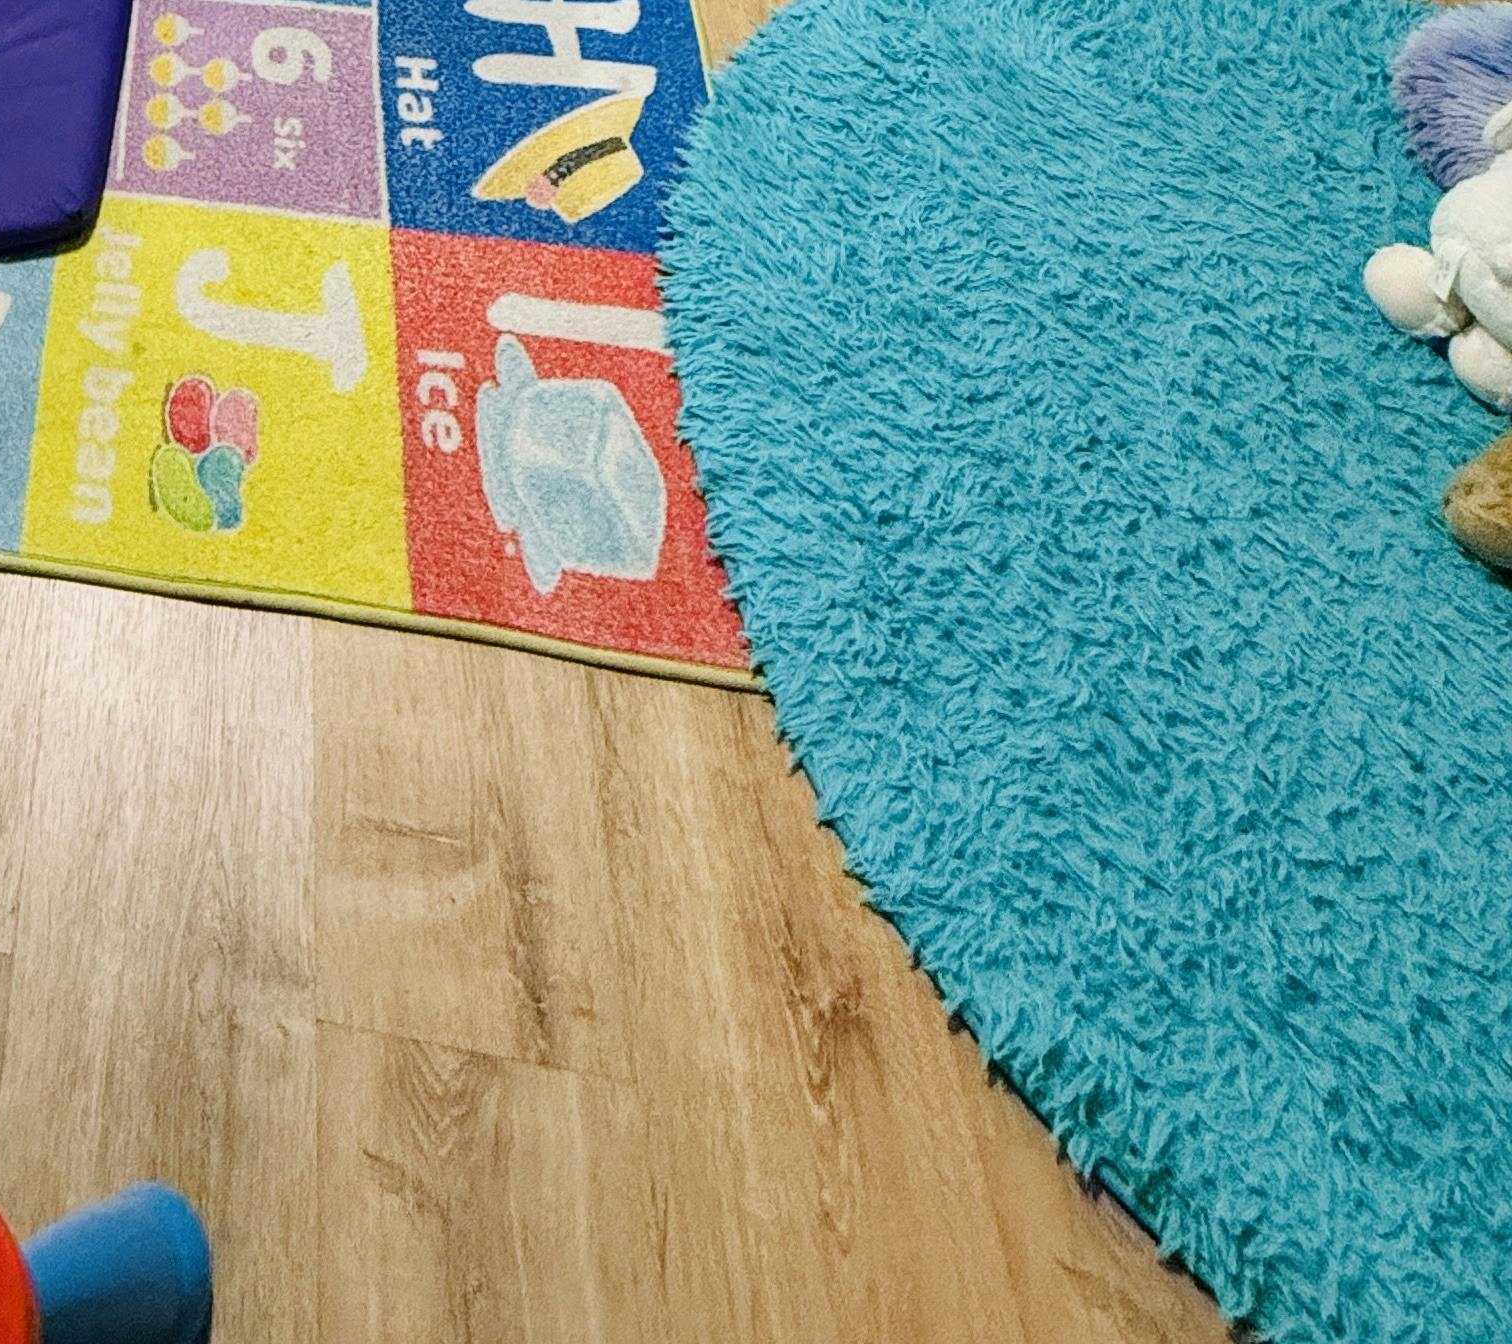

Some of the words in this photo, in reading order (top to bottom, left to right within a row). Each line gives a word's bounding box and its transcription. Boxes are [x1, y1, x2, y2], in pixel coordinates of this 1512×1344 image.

[246, 23, 336, 90] 6
[389, 52, 447, 153] Hat
[269, 112, 302, 171] Six
[92, 217, 144, 357] Jelly
[172, 244, 371, 396] J
[72, 365, 131, 526] bean
[413, 345, 470, 459] Ice
